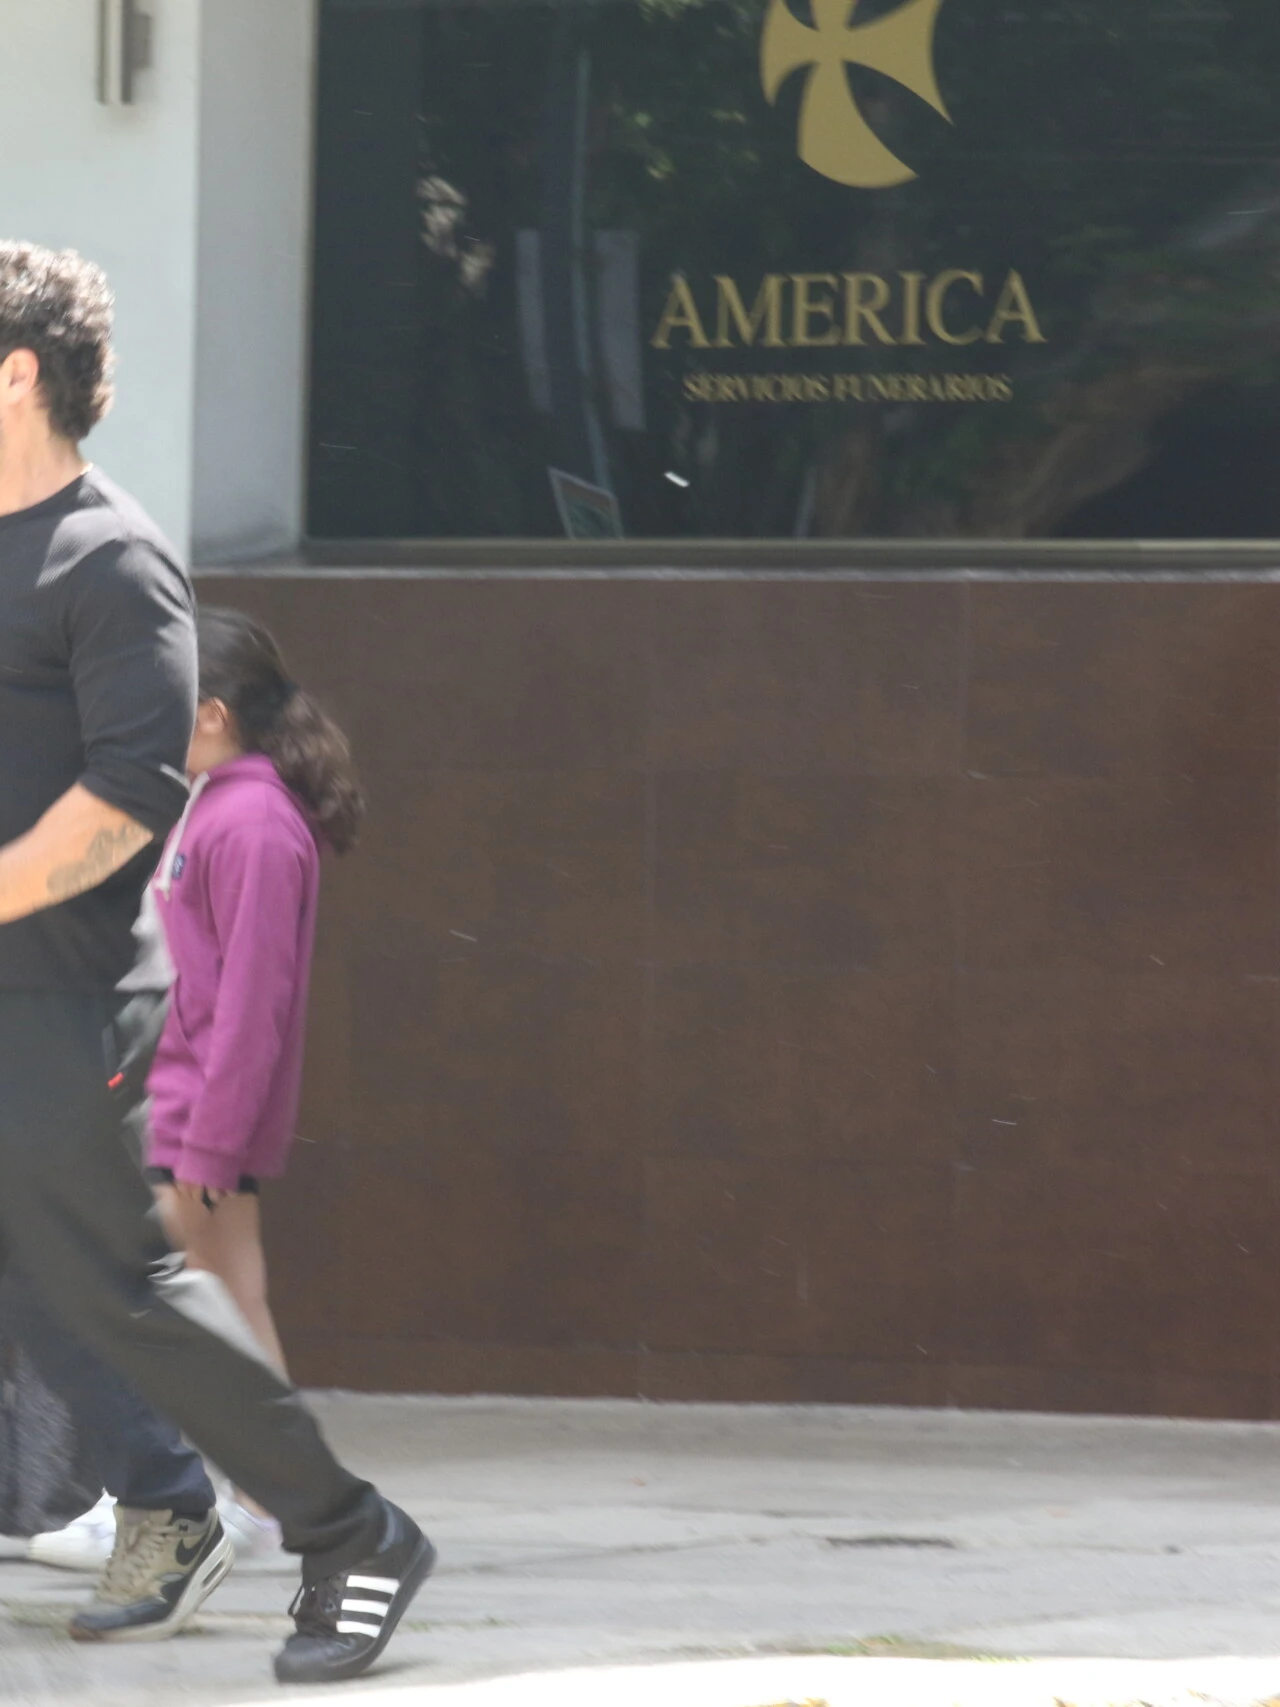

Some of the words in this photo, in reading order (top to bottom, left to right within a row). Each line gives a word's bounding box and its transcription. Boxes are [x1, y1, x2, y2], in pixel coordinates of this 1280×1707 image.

[649, 267, 1049, 349] AMERICA
[682, 372, 830, 402] SERVICIOS
[832, 371, 1015, 402] FUNERARIOS
